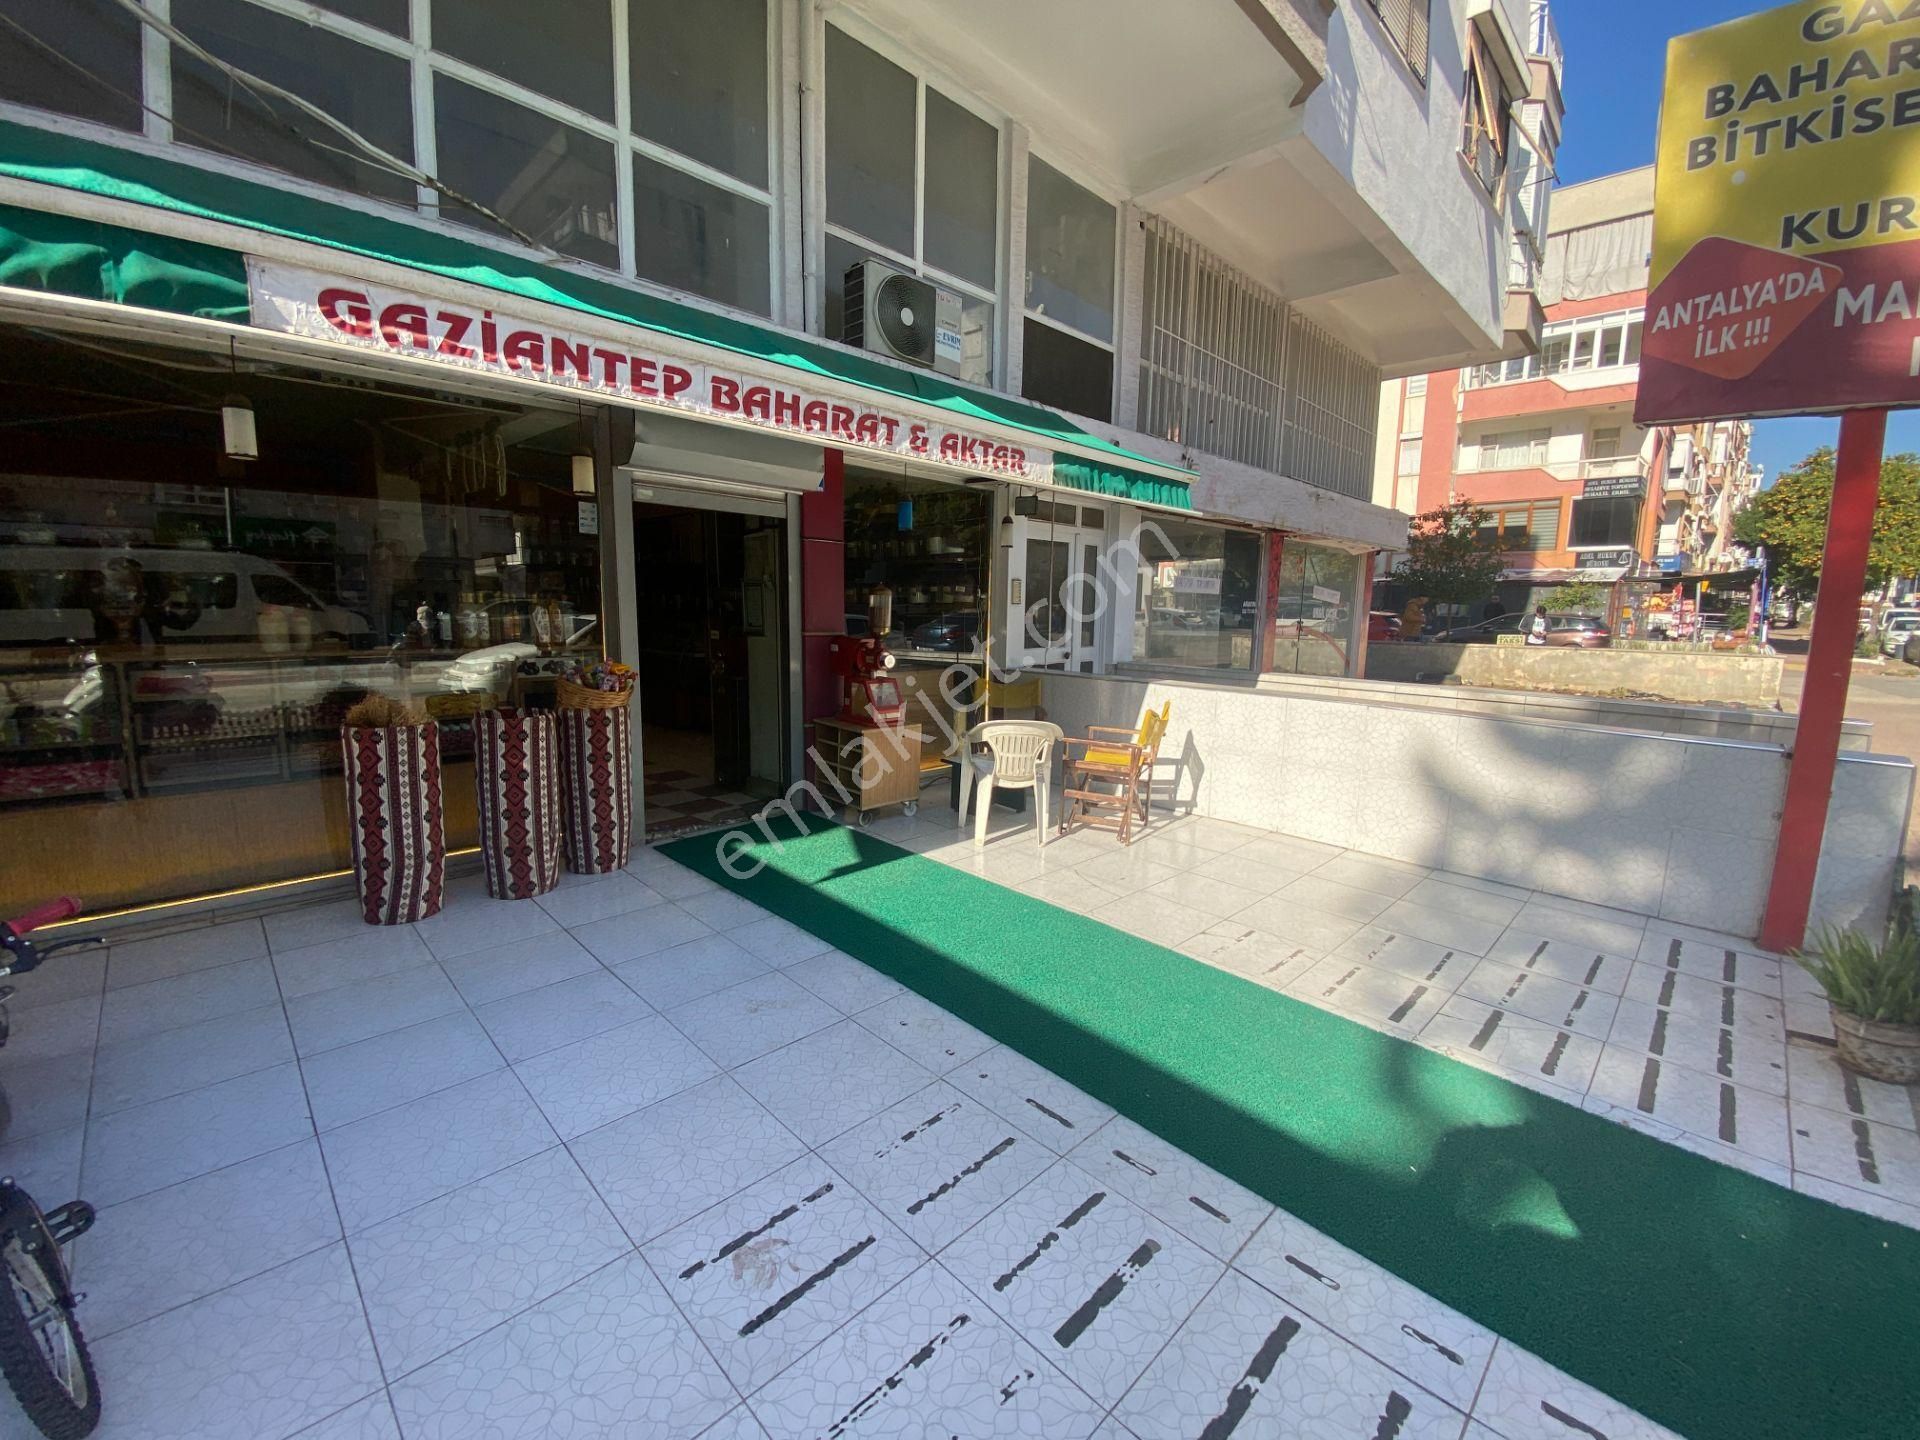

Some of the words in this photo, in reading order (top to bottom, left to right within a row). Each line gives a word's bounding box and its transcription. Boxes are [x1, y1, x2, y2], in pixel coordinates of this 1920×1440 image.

[1781, 197, 1918, 249] KUR
[1651, 266, 1826, 334] ANTALYA'DA
[1833, 280, 1920, 327] MA
[317, 288, 693, 401] GAZİANTEP
[710, 376, 900, 446] BAHARAT
[909, 425, 929, 453] &
[940, 432, 1027, 476] AKTAR
